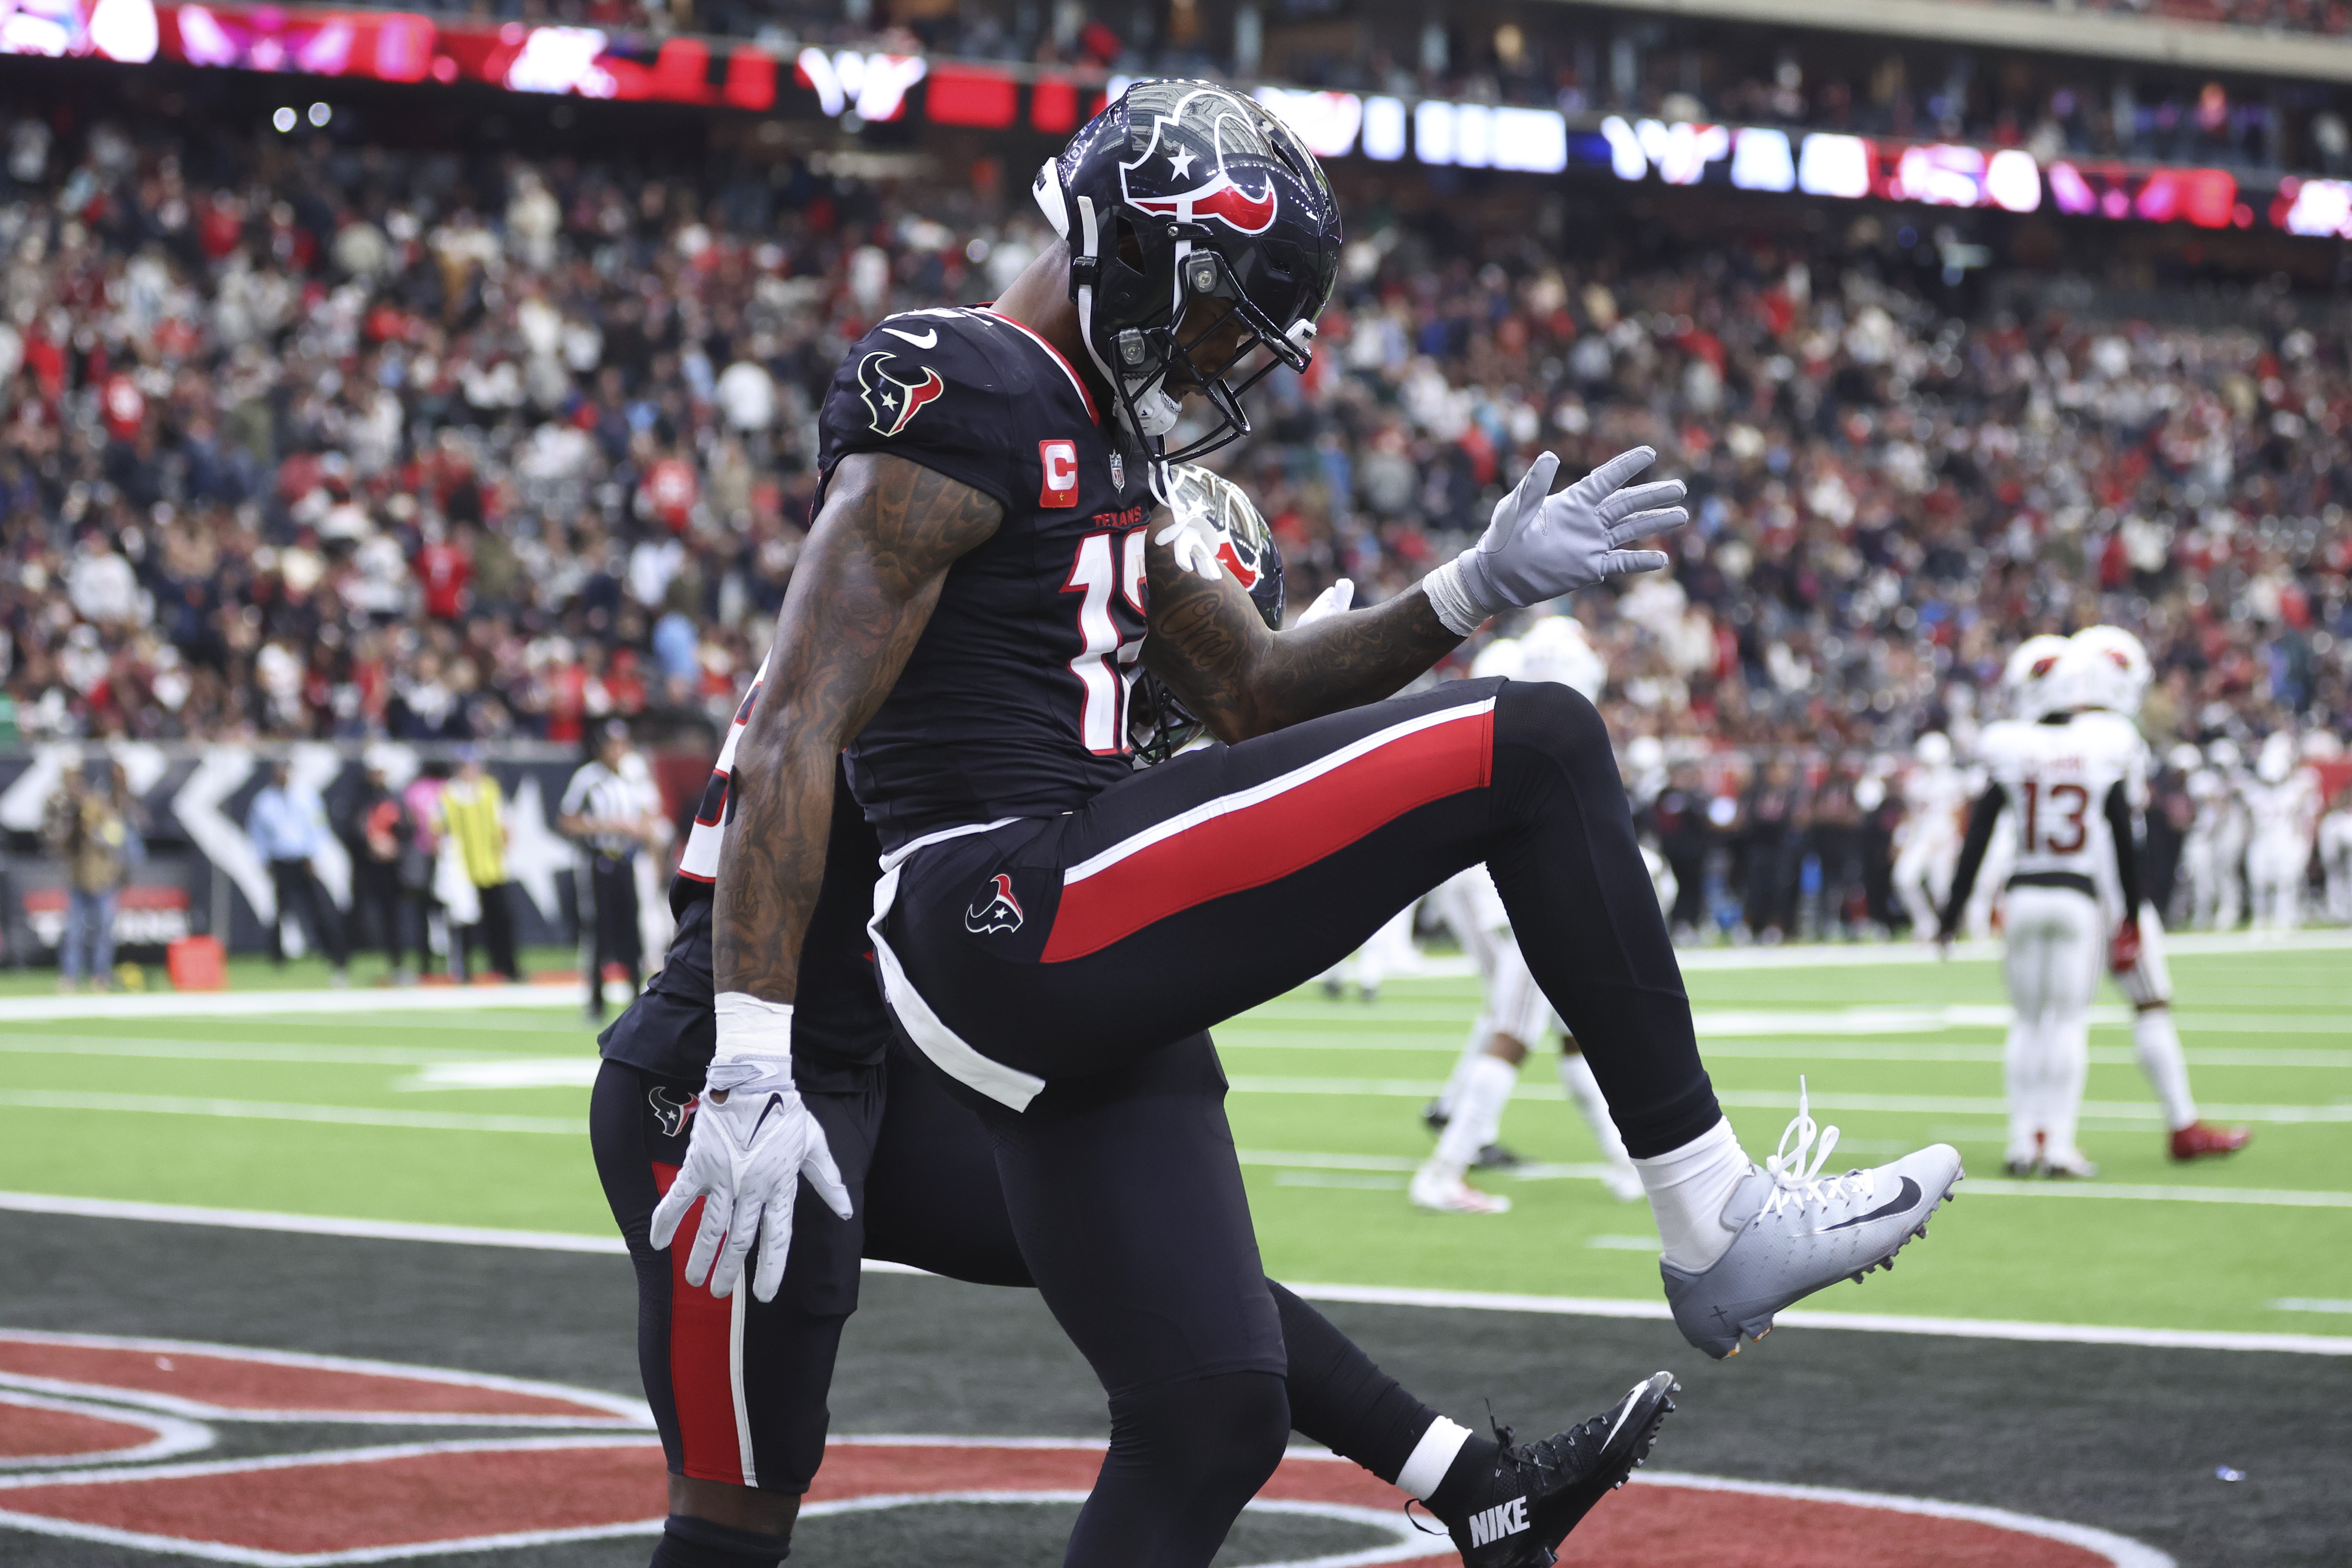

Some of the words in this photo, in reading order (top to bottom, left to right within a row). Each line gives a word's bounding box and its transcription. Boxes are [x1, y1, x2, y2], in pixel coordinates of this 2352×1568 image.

[1044, 444, 1077, 491] C
[1092, 506, 1142, 527] TEXANS
[2023, 779, 2088, 853] 13
[1468, 1495, 1530, 1549] NIKE
